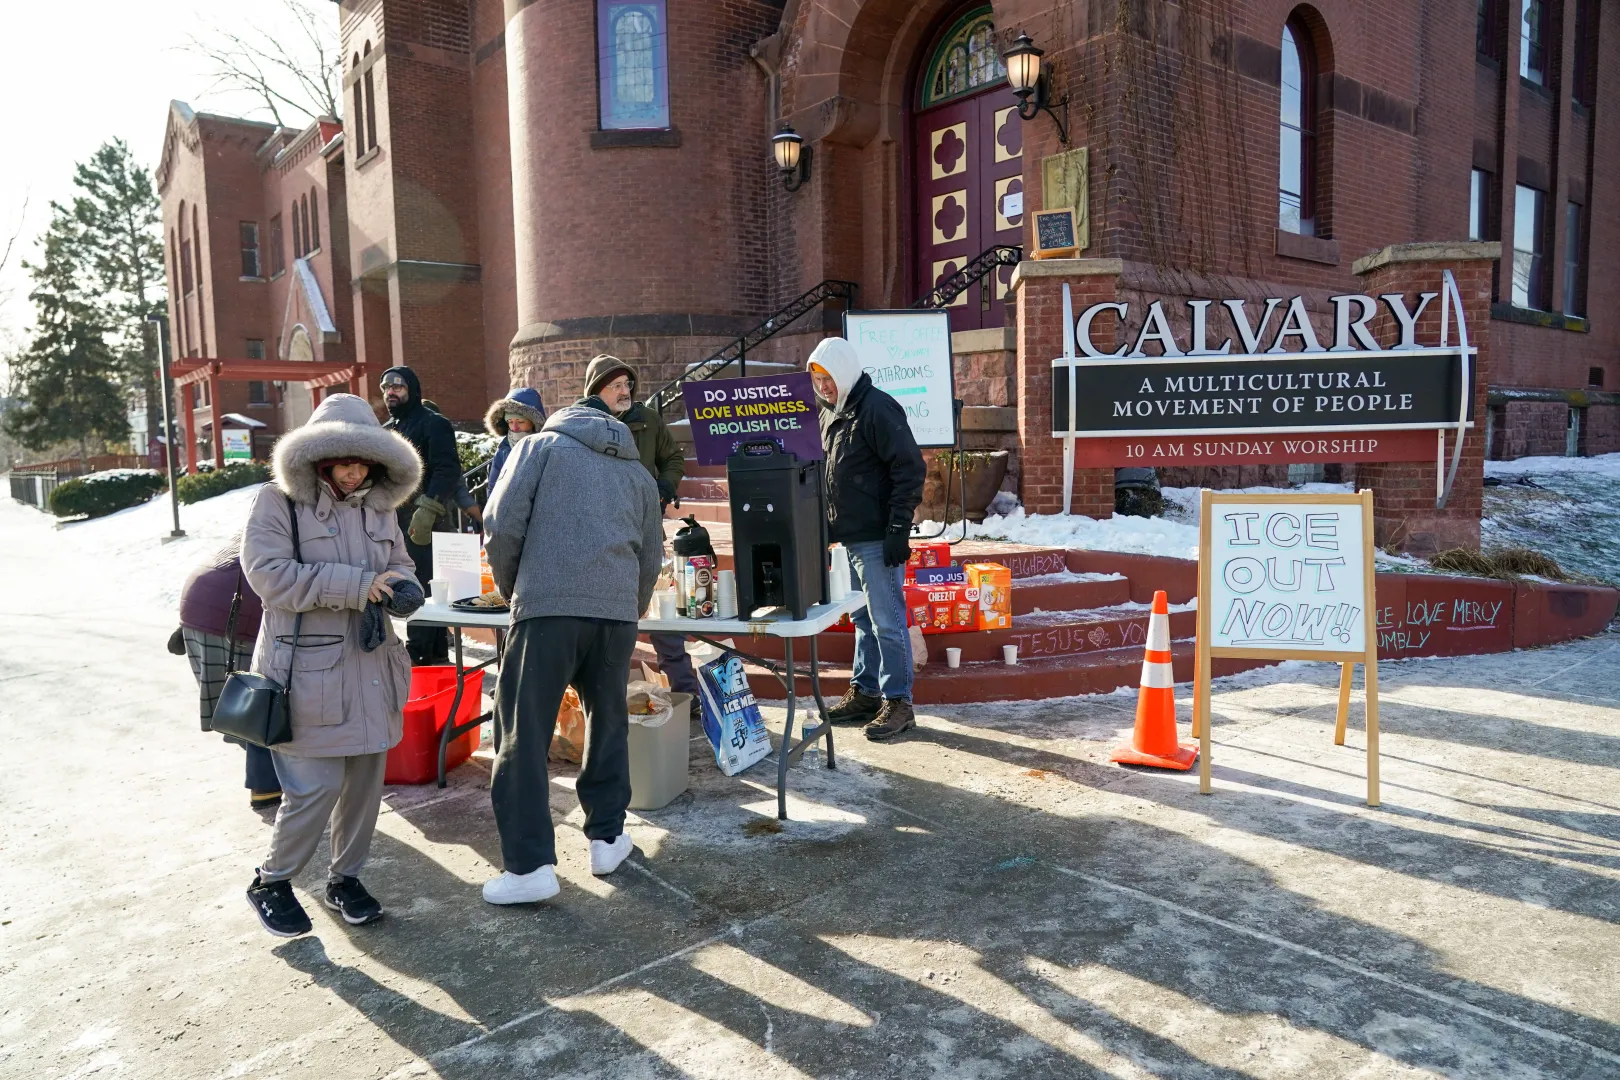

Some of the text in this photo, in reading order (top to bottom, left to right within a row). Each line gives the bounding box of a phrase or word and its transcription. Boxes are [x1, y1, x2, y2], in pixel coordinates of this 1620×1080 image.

[858, 320, 899, 345] FREE
[1075, 292, 1438, 358] CALVARY
[704, 384, 793, 403] DO JUSTICE.
[1138, 371, 1387, 394] A MULTICULTURAL
[693, 400, 810, 420] LOVE KINDNESS.
[1112, 394, 1413, 417] MOVEMENT OF PEOPLE
[709, 417, 802, 436] ABOLISH ICE.
[1125, 438, 1379, 459] 10 AM SUNDAY WORSHIP
[1223, 511, 1340, 550] ICE
[1002, 553, 1066, 577] NEIGHBORS
[1223, 555, 1347, 595] OUT
[929, 574, 944, 583] DO
[1219, 597, 1361, 644] NOW!!
[1406, 599, 1446, 627] LOVE
[1451, 598, 1503, 625] MERCY
[1010, 628, 1085, 654] JESUS
[723, 698, 742, 715] ICE
